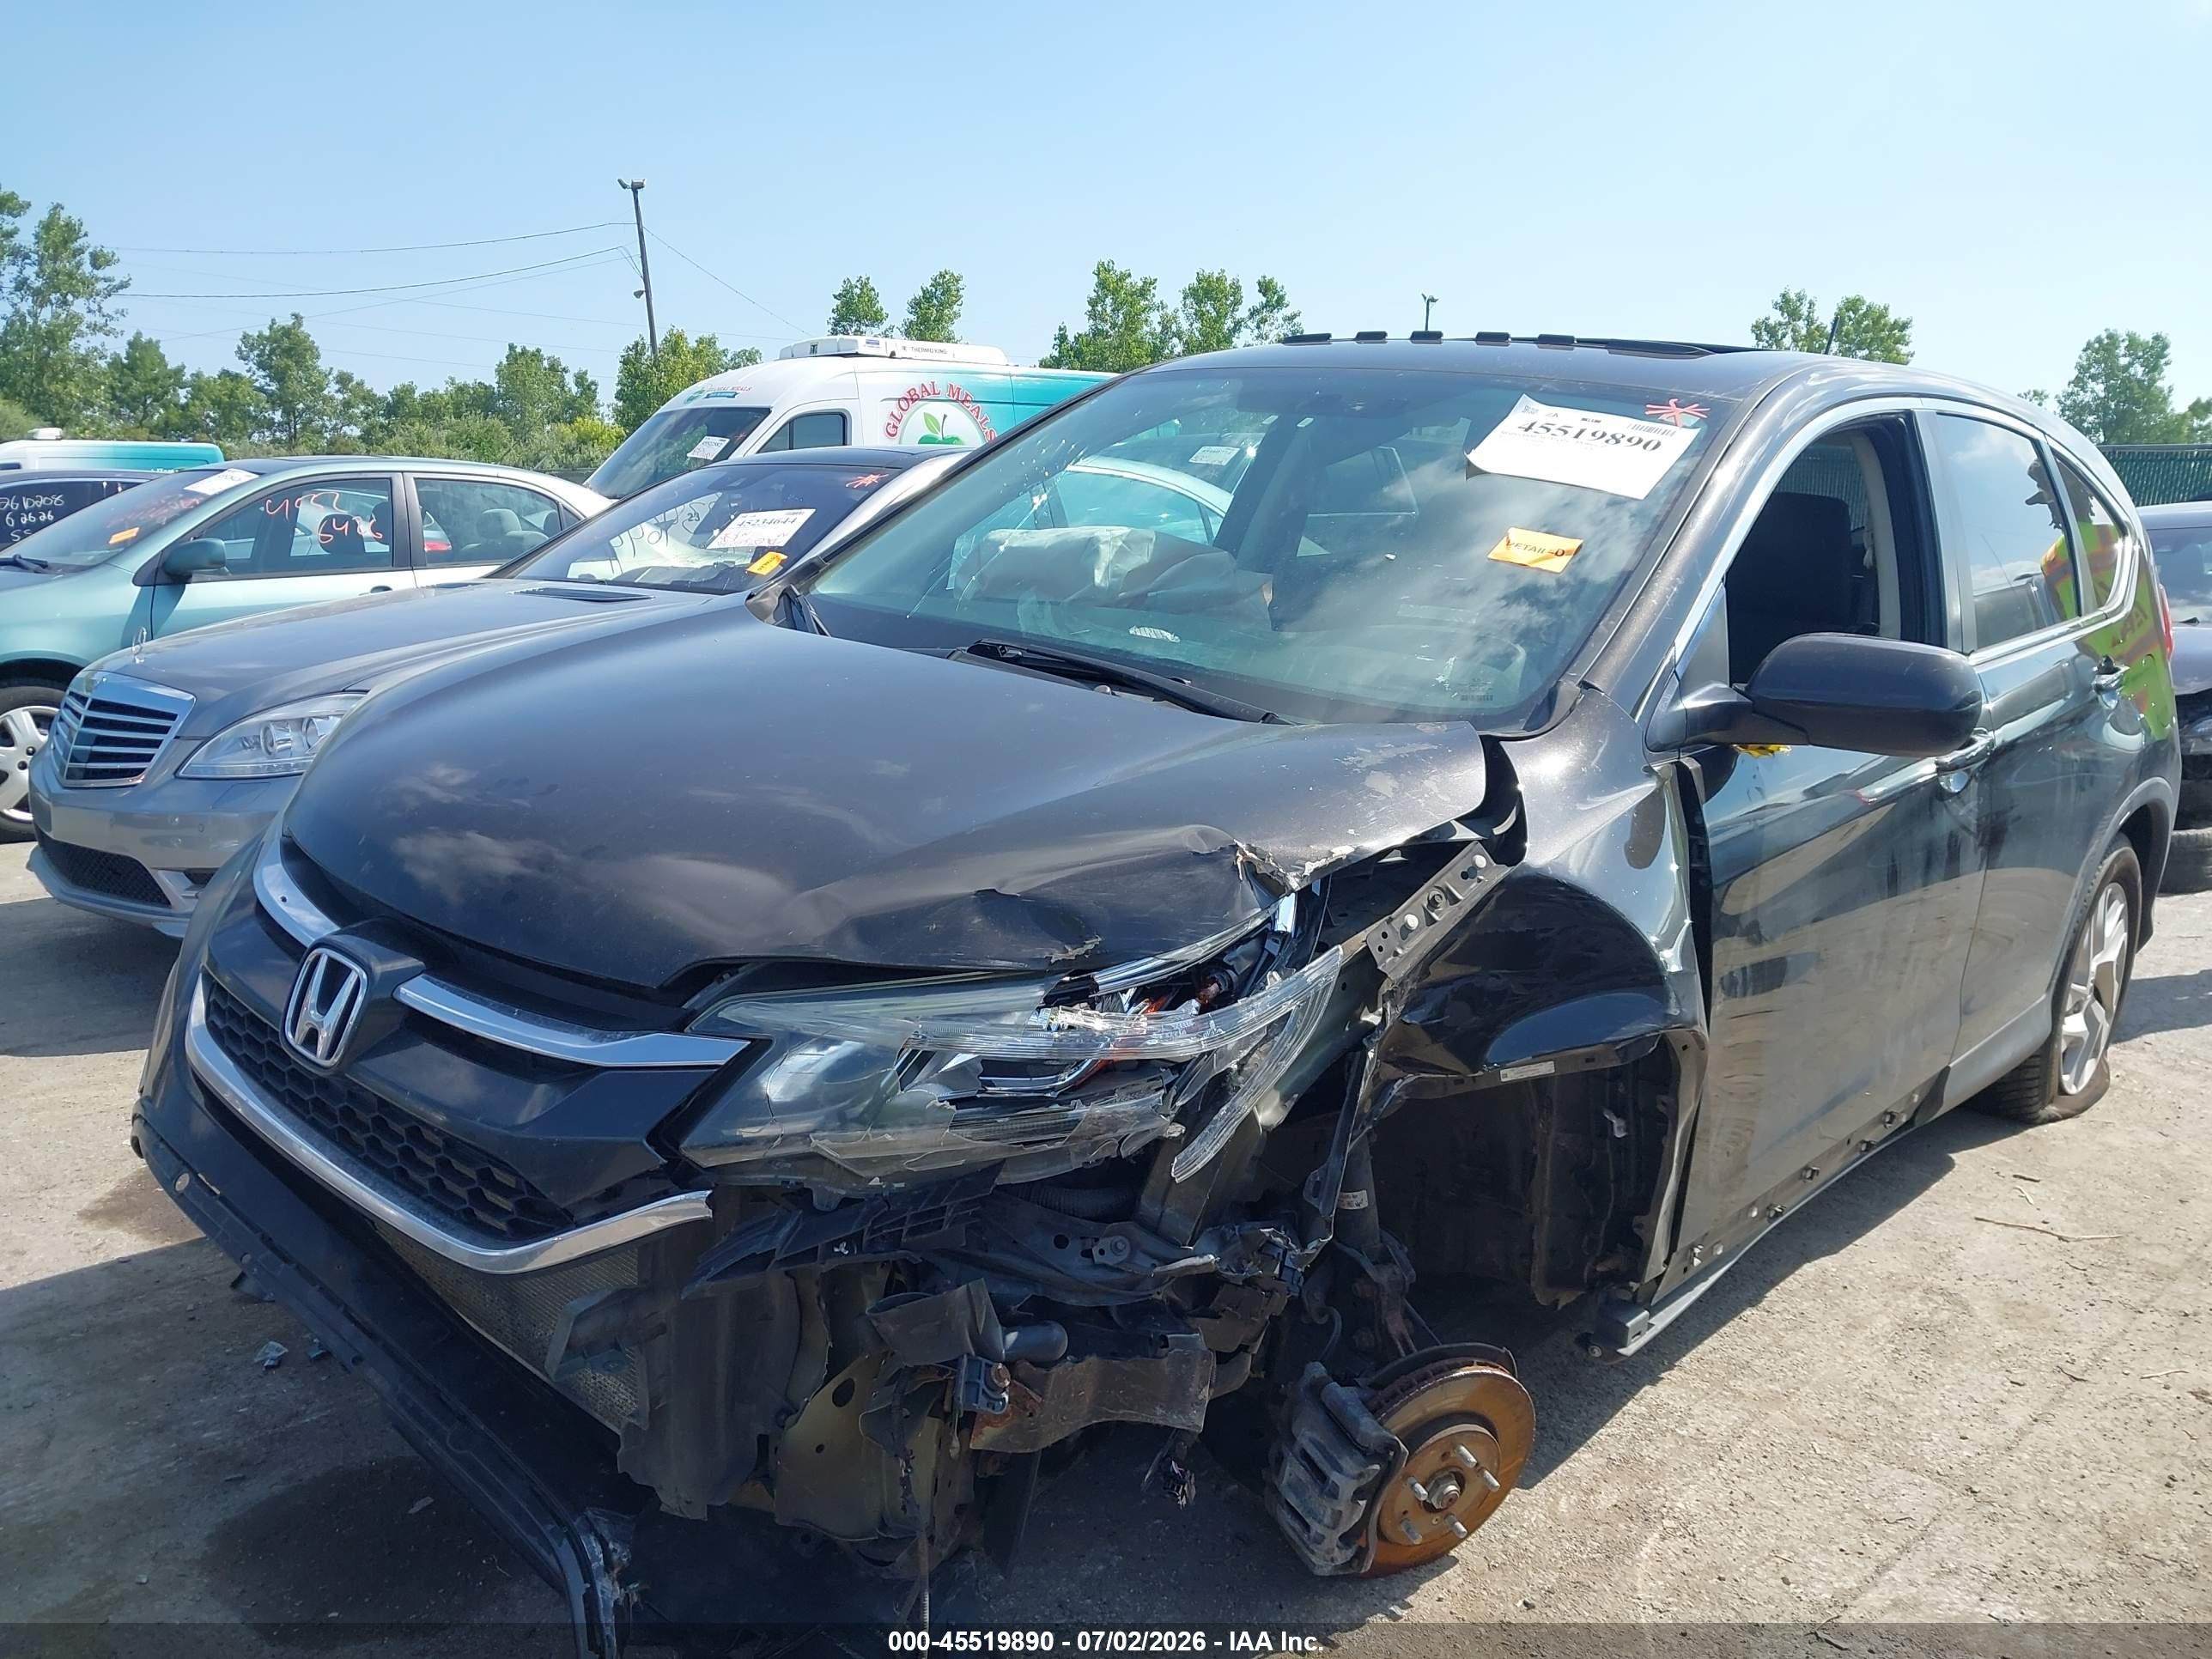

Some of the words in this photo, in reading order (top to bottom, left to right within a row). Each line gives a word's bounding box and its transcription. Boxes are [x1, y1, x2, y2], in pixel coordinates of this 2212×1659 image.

[884, 380, 941, 439] GLOBAL
[947, 383, 998, 443] MEALS
[1517, 420, 1662, 452] 45519890
